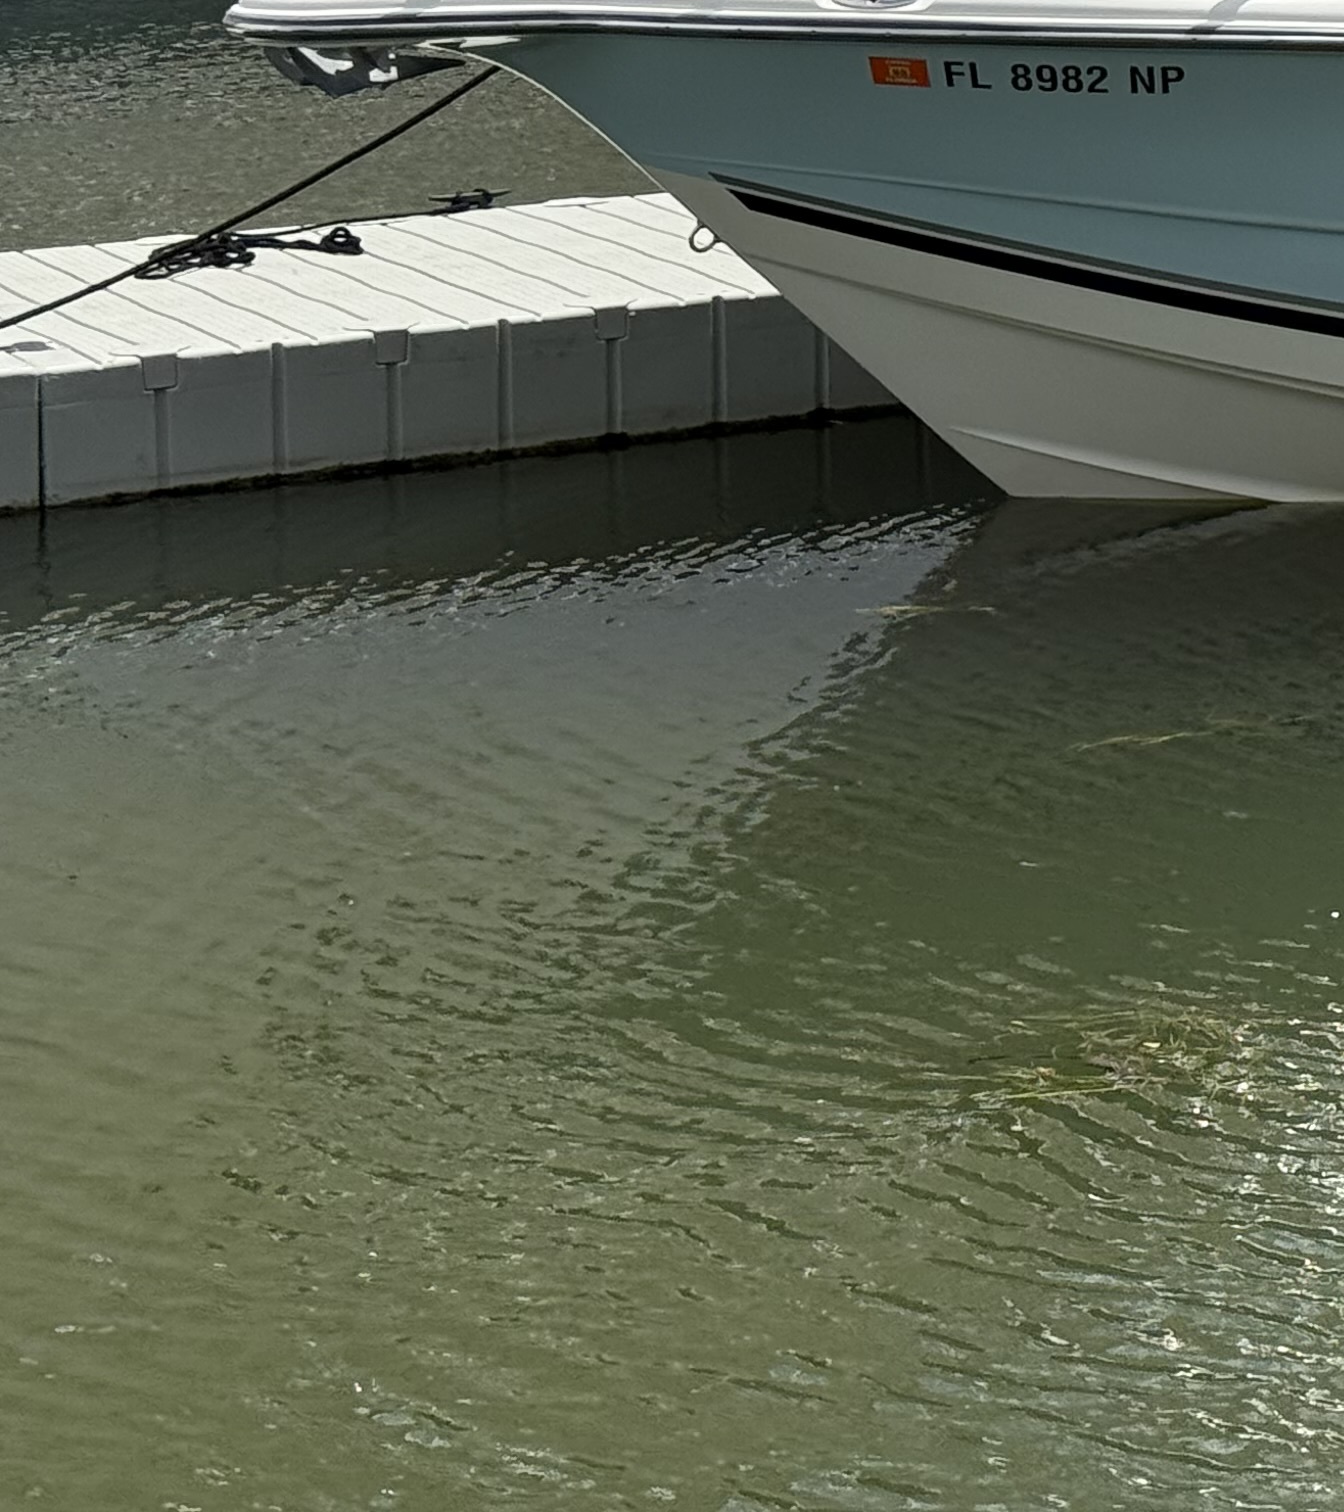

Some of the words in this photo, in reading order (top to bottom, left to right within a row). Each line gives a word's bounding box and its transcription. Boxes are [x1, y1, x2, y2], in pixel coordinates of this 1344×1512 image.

[943, 60, 993, 90] FL
[1010, 63, 1110, 94] 8982
[1129, 65, 1186, 94] NP
